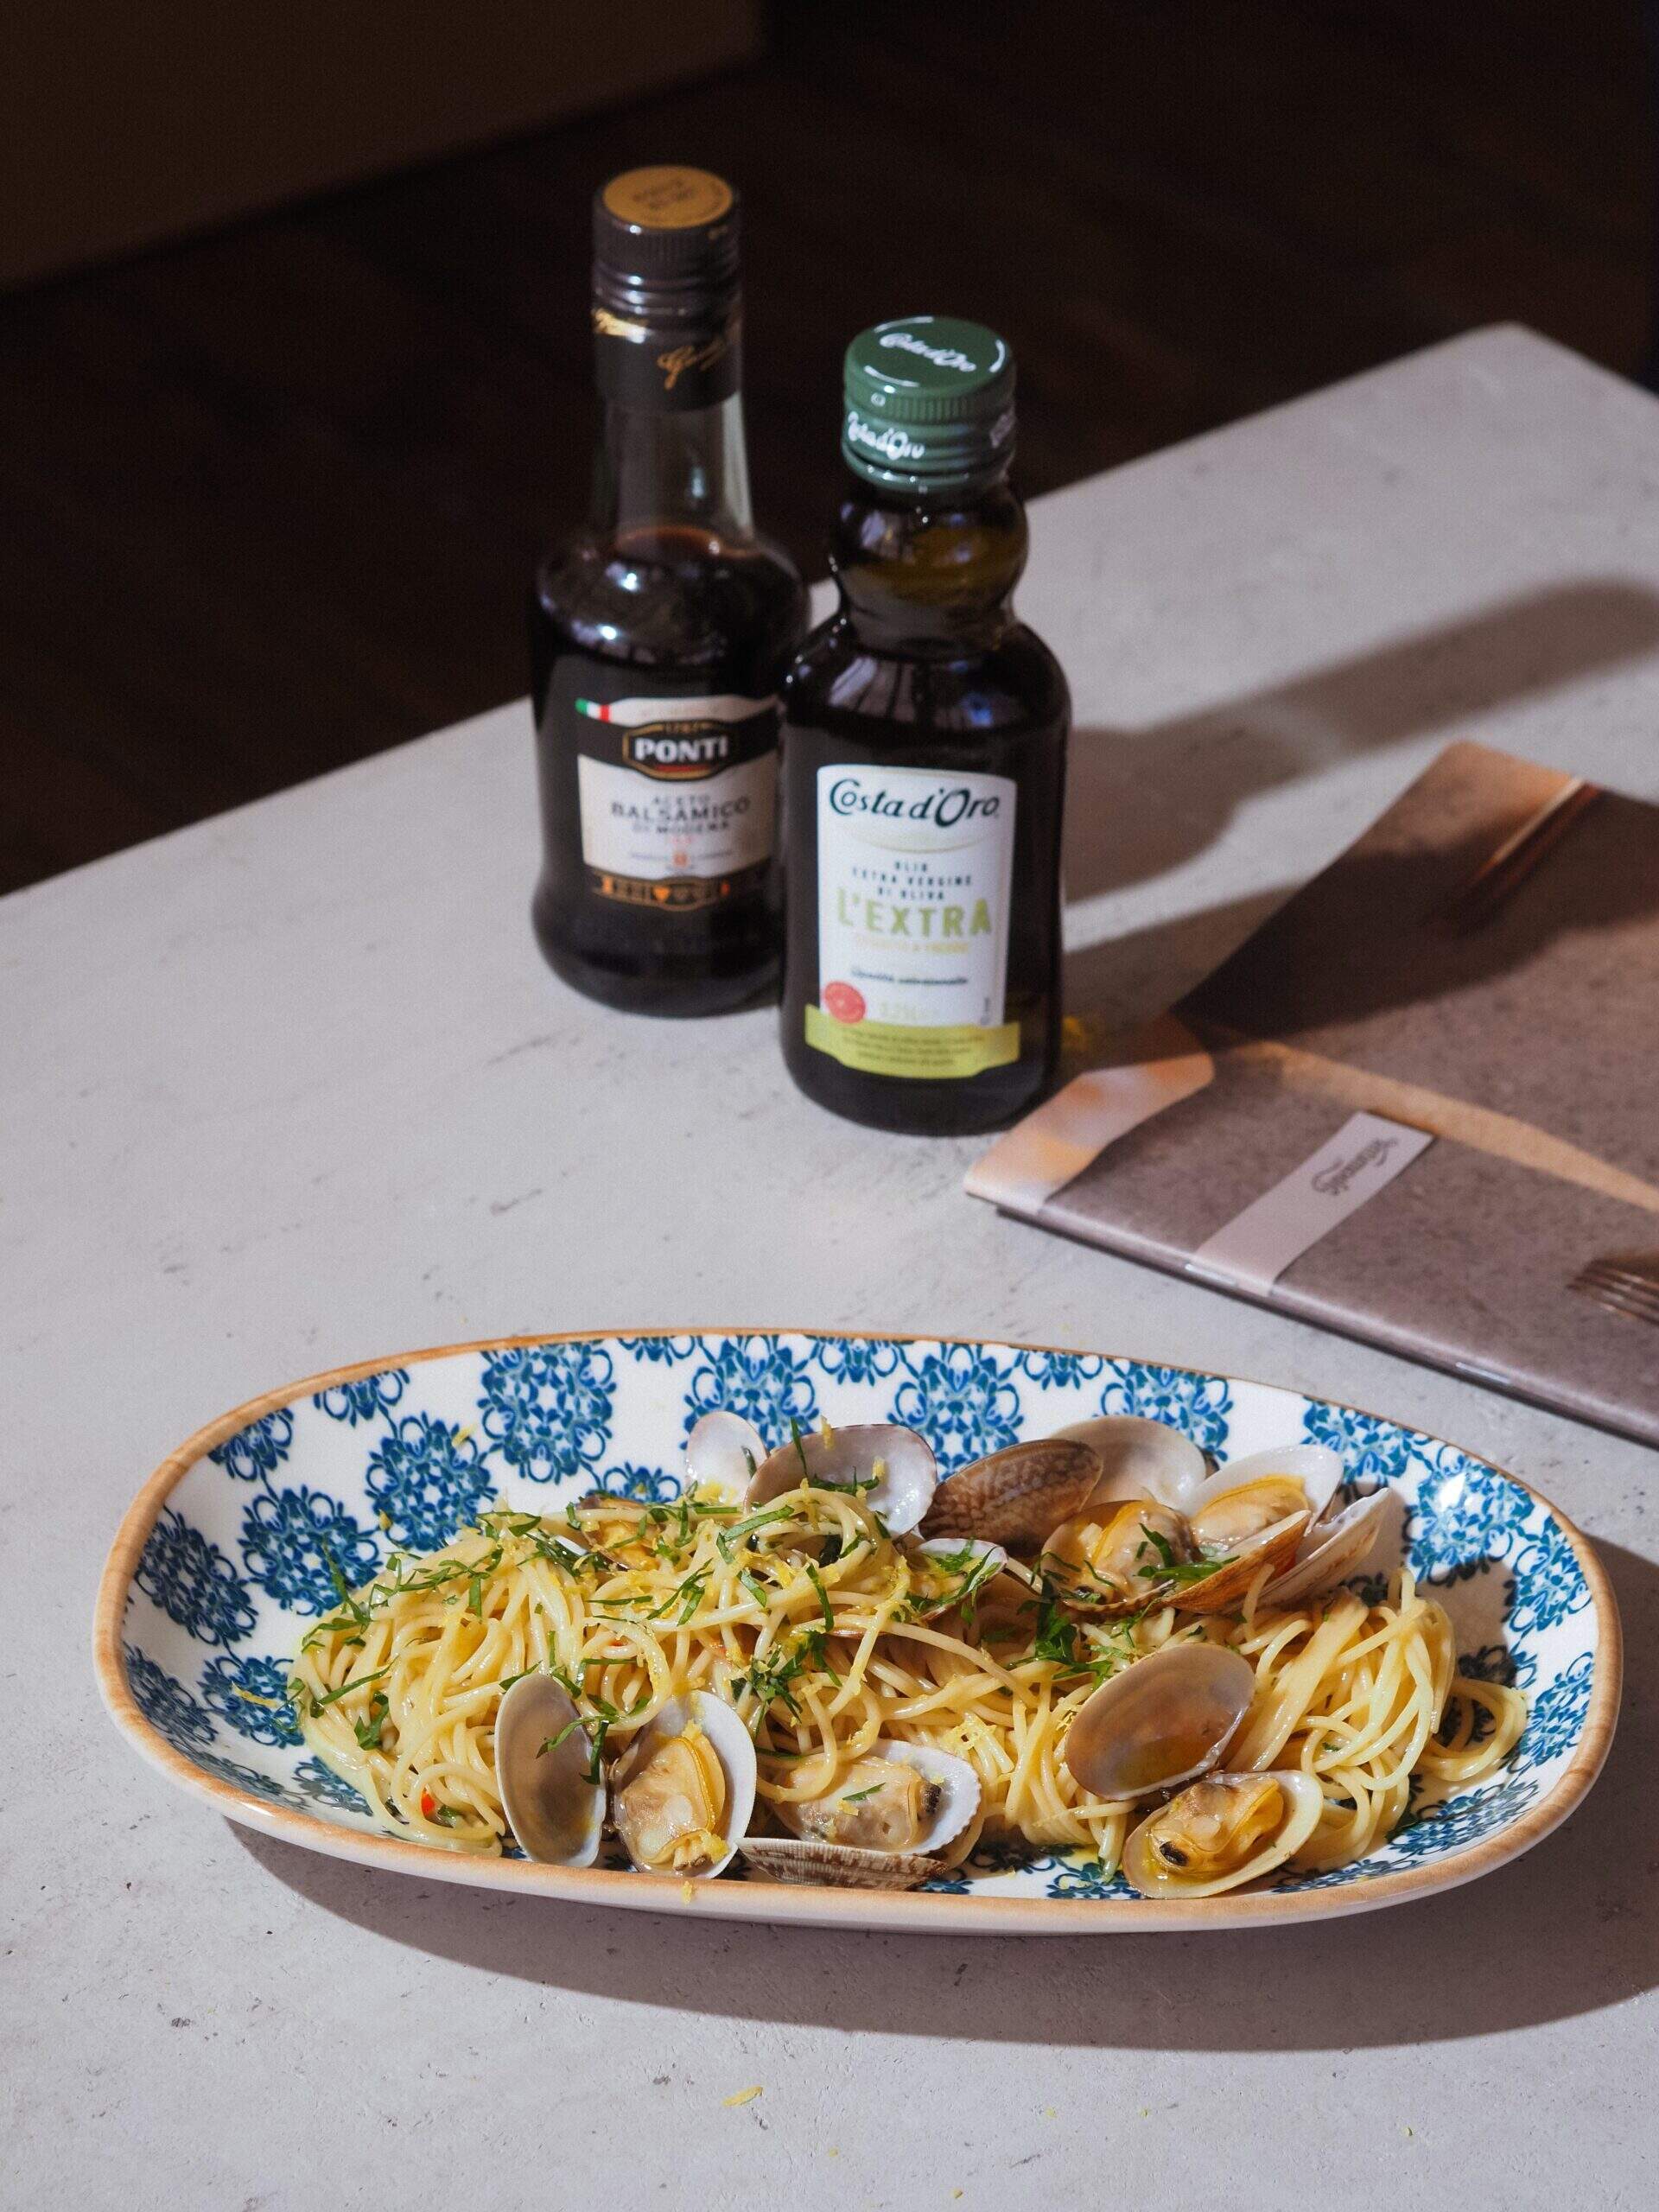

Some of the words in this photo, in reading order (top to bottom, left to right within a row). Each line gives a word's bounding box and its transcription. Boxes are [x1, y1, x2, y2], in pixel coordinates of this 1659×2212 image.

[634, 736, 728, 763] PONTI
[611, 797, 750, 821] BALSAMICO
[829, 778, 905, 817] Costa
[908, 787, 1000, 828] d'Oro
[837, 888, 991, 937] L'EXTRA
